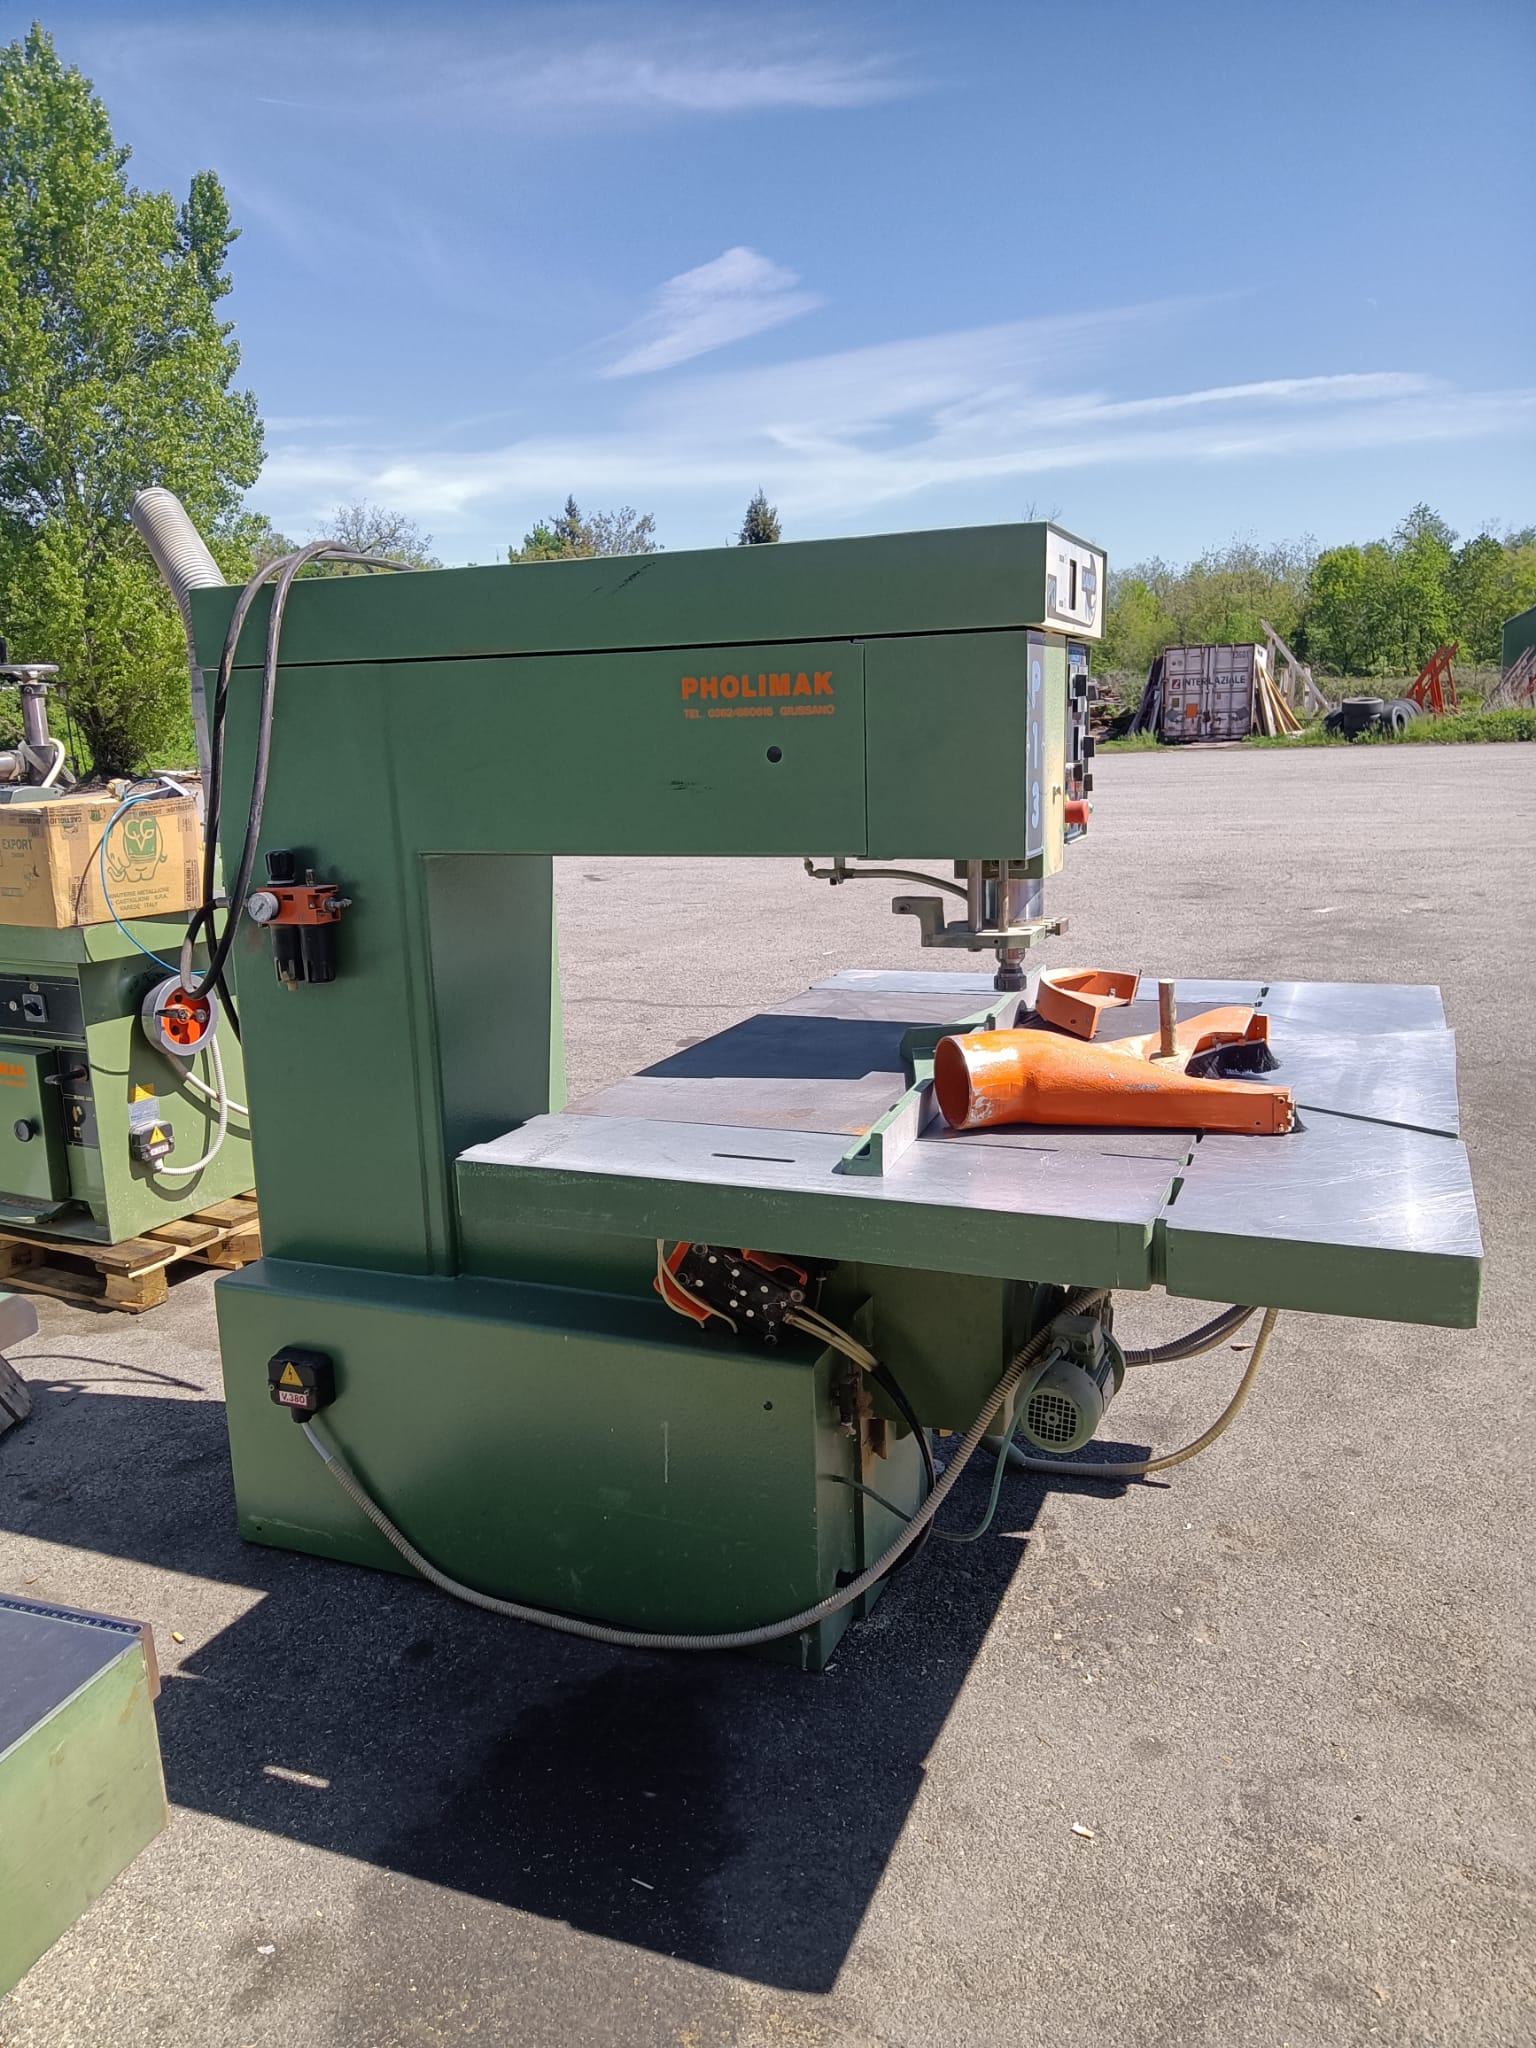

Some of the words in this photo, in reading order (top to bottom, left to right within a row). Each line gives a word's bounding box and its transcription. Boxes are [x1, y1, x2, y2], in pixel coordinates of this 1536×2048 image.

[681, 672, 833, 700] PHOLIMAK
[2, 839, 33, 850] EXPORT
[281, 1392, 306, 1404] V.380
